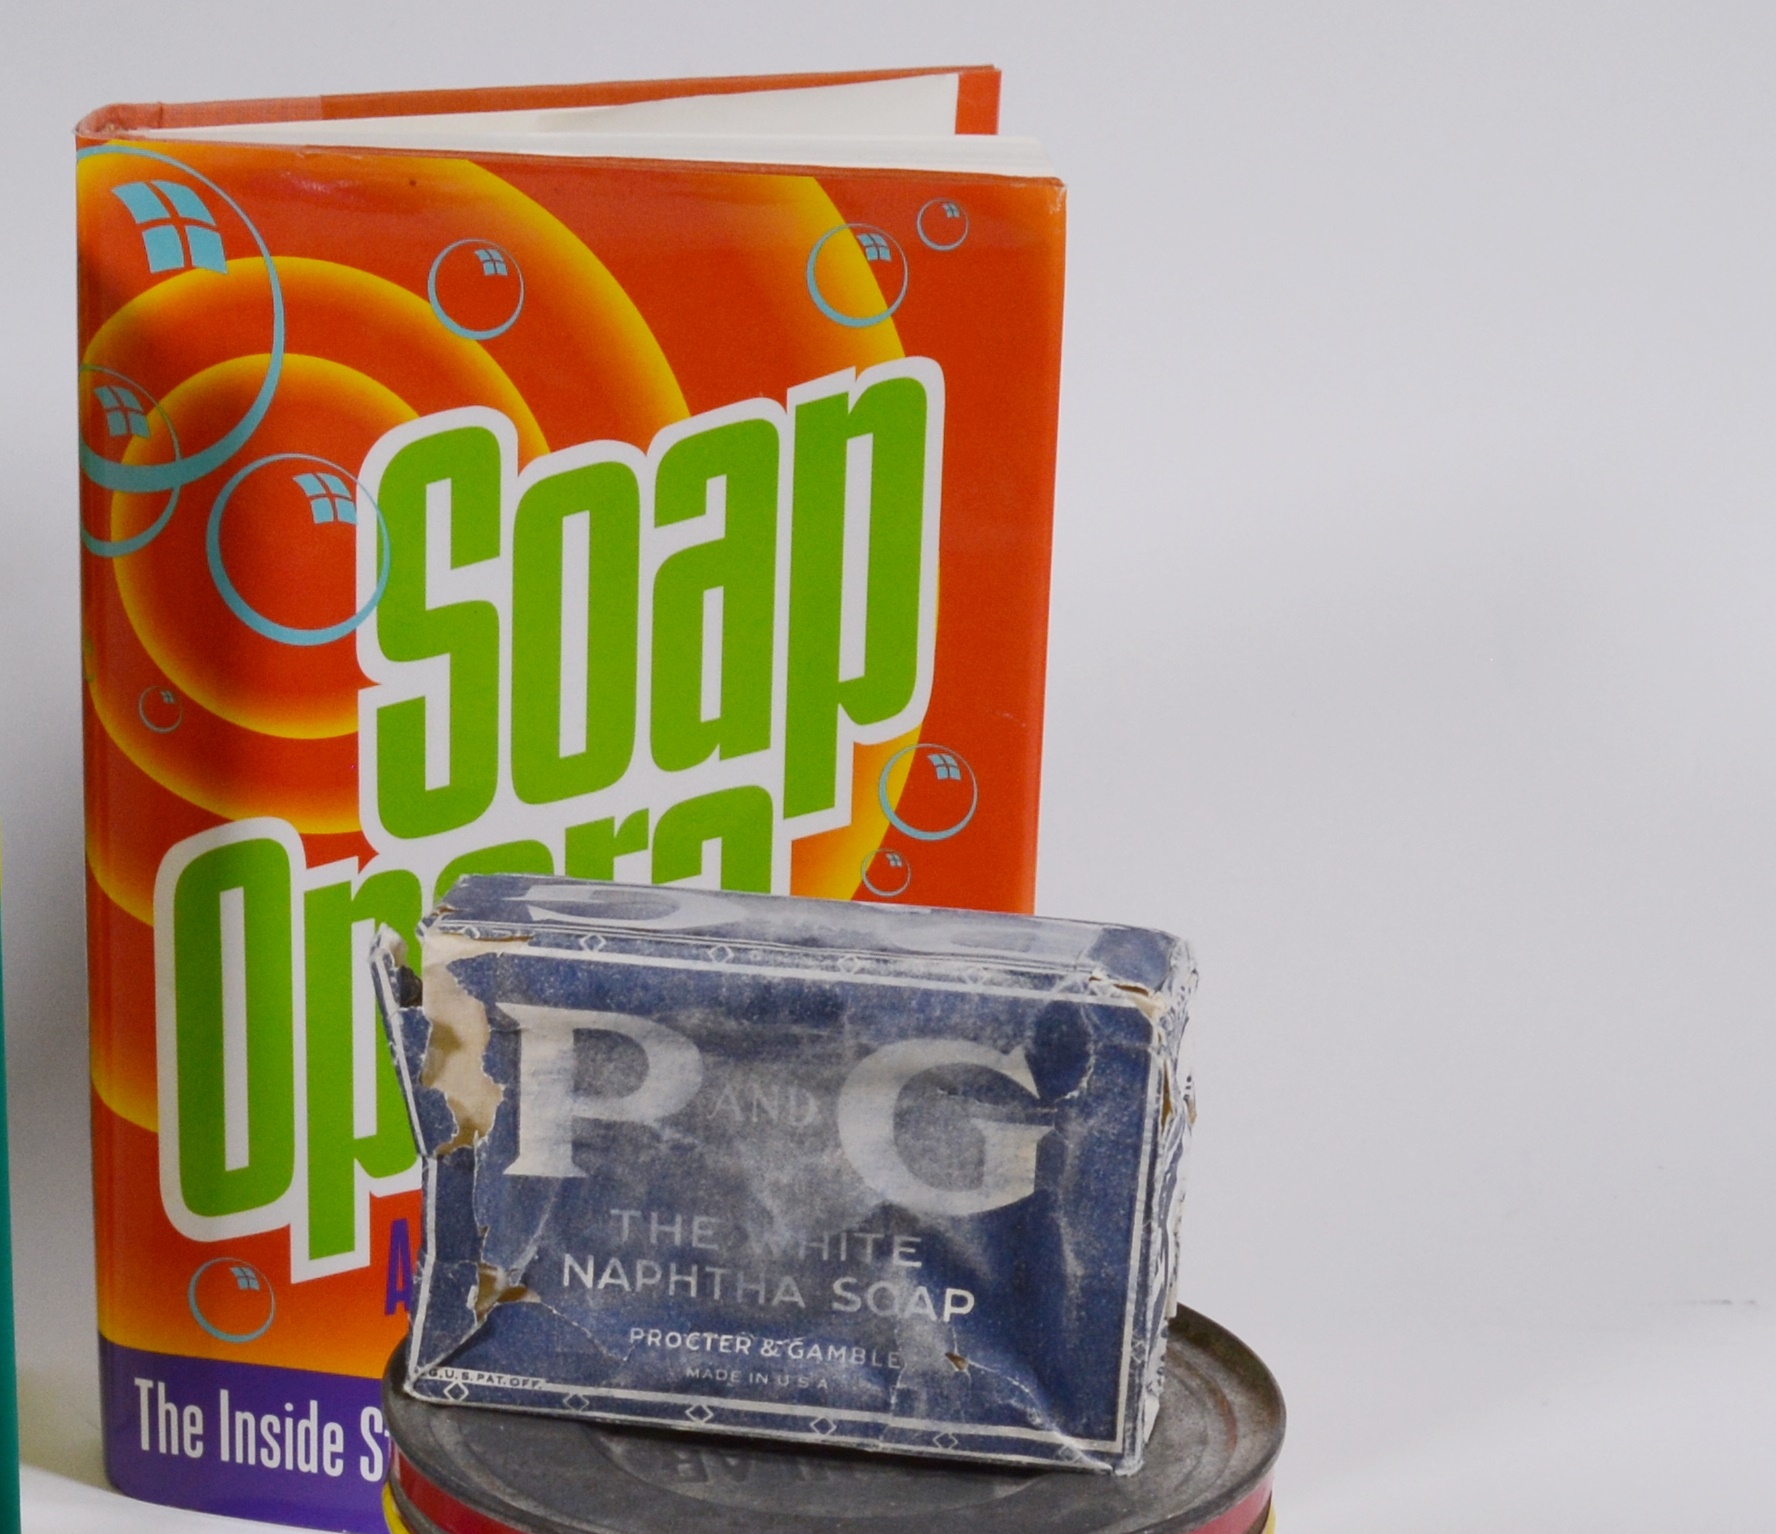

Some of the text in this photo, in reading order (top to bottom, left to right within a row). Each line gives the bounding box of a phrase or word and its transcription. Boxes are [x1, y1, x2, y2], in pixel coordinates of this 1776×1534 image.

[358, 358, 946, 843] Soap
[495, 1001, 1056, 1217] P AND G
[609, 1209, 719, 1252] THE
[560, 1256, 977, 1324] NAPHTHA SOAP
[629, 1327, 903, 1370] PROCTER & GAMBLE
[685, 1365, 742, 1385] MADE
[749, 1371, 769, 1386] IN
[133, 1376, 392, 1484] The Inside S
